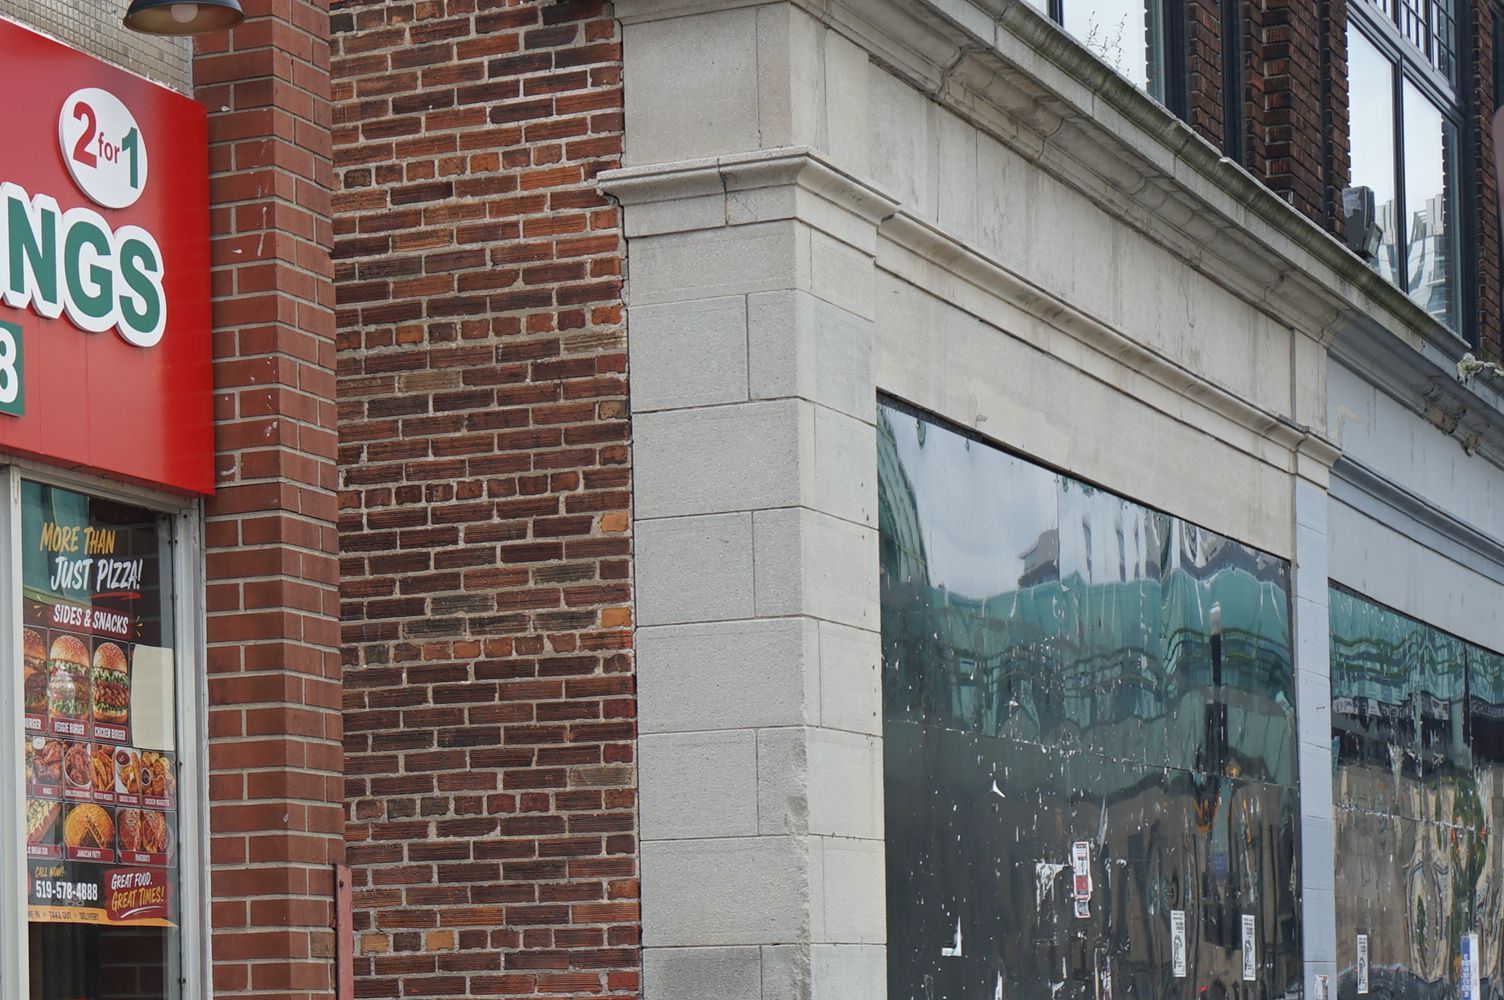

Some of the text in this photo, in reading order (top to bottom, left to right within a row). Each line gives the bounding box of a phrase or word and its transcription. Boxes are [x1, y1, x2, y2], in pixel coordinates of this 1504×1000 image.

[40, 522, 116, 554] MORE THAN
[51, 556, 143, 592] JUST PIZZA!
[54, 604, 129, 635] SIDES & SNACKS
[35, 880, 98, 901] 519-578-4888
[111, 872, 153, 890] GREAT FOOD.
[111, 886, 164, 912] GREAT TIMES!
